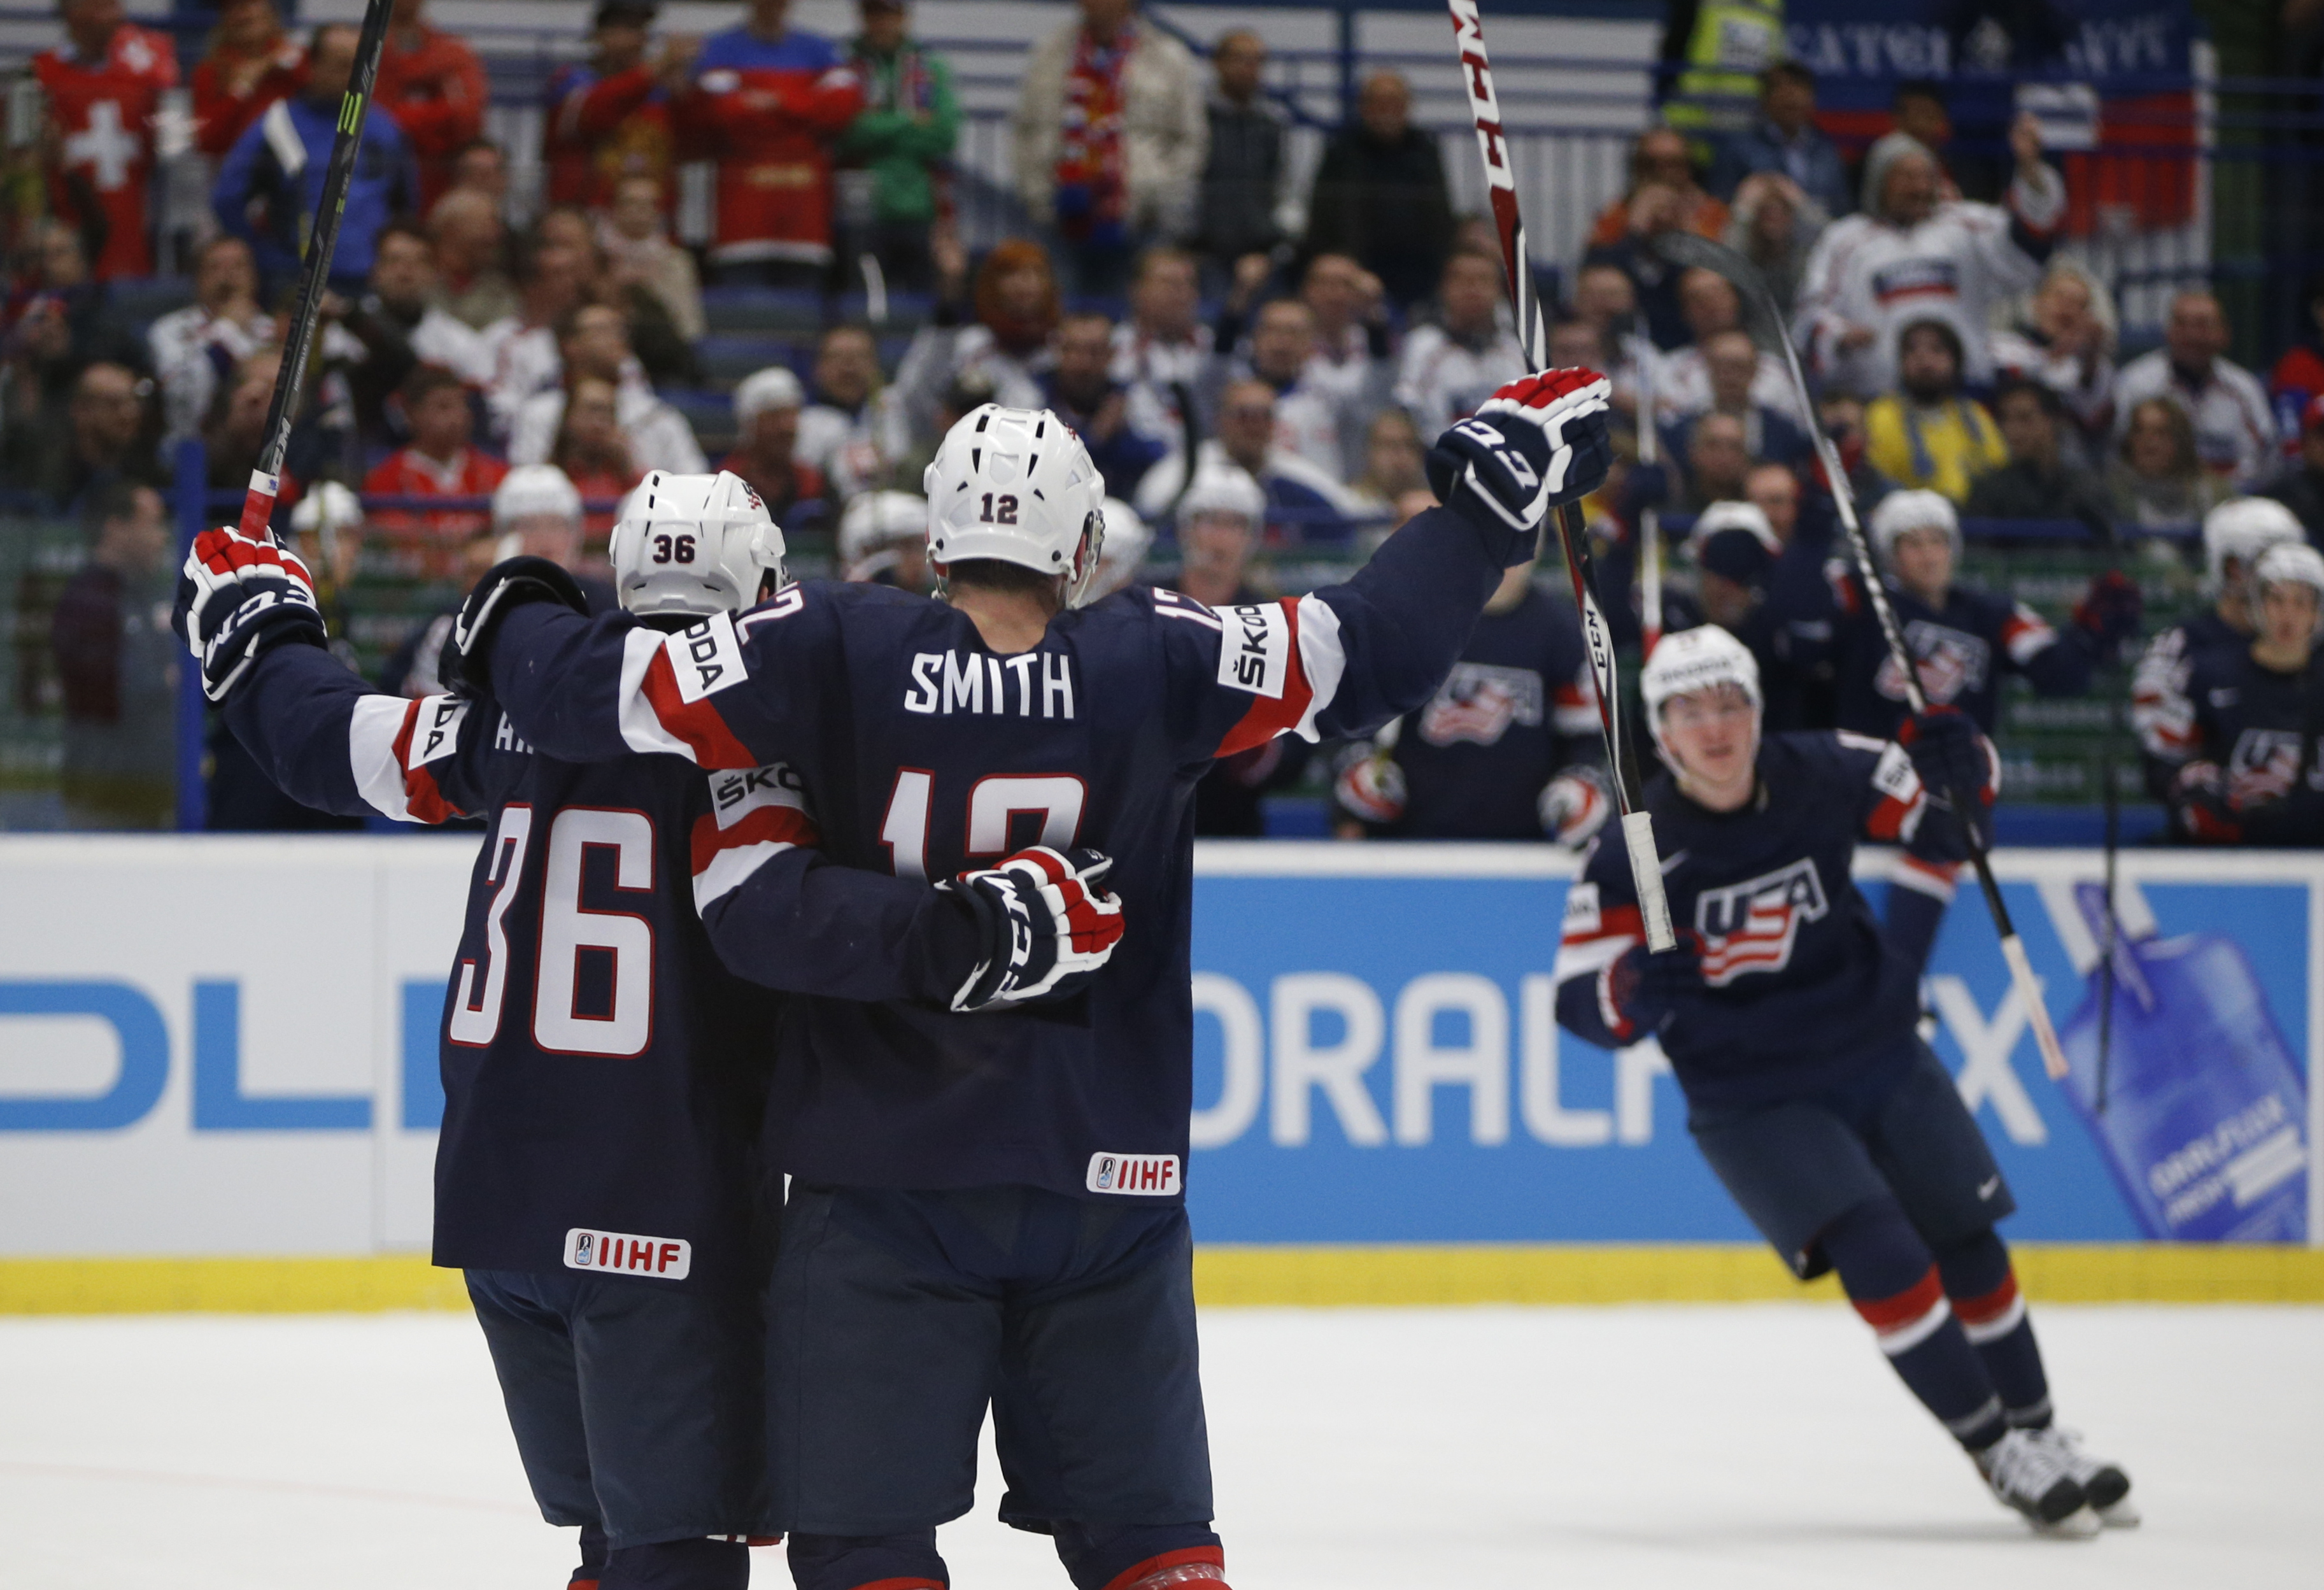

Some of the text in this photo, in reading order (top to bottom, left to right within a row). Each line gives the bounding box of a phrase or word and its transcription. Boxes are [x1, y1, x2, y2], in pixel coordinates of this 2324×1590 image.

[1449, 0, 1515, 191] CCM
[270, 416, 292, 476] CM
[1440, 418, 1540, 490] CC
[980, 492, 1018, 525] 12
[653, 534, 695, 564] 36
[684, 618, 724, 692] ODA
[1233, 605, 1269, 688] ŠKOD
[1586, 609, 1607, 669] CCM
[903, 648, 1075, 720] SMITH
[716, 766, 807, 811] ŠKO
[448, 803, 656, 1060] 36
[1117, 1160, 1173, 1190] IIHF
[599, 1237, 681, 1273] IIHF
